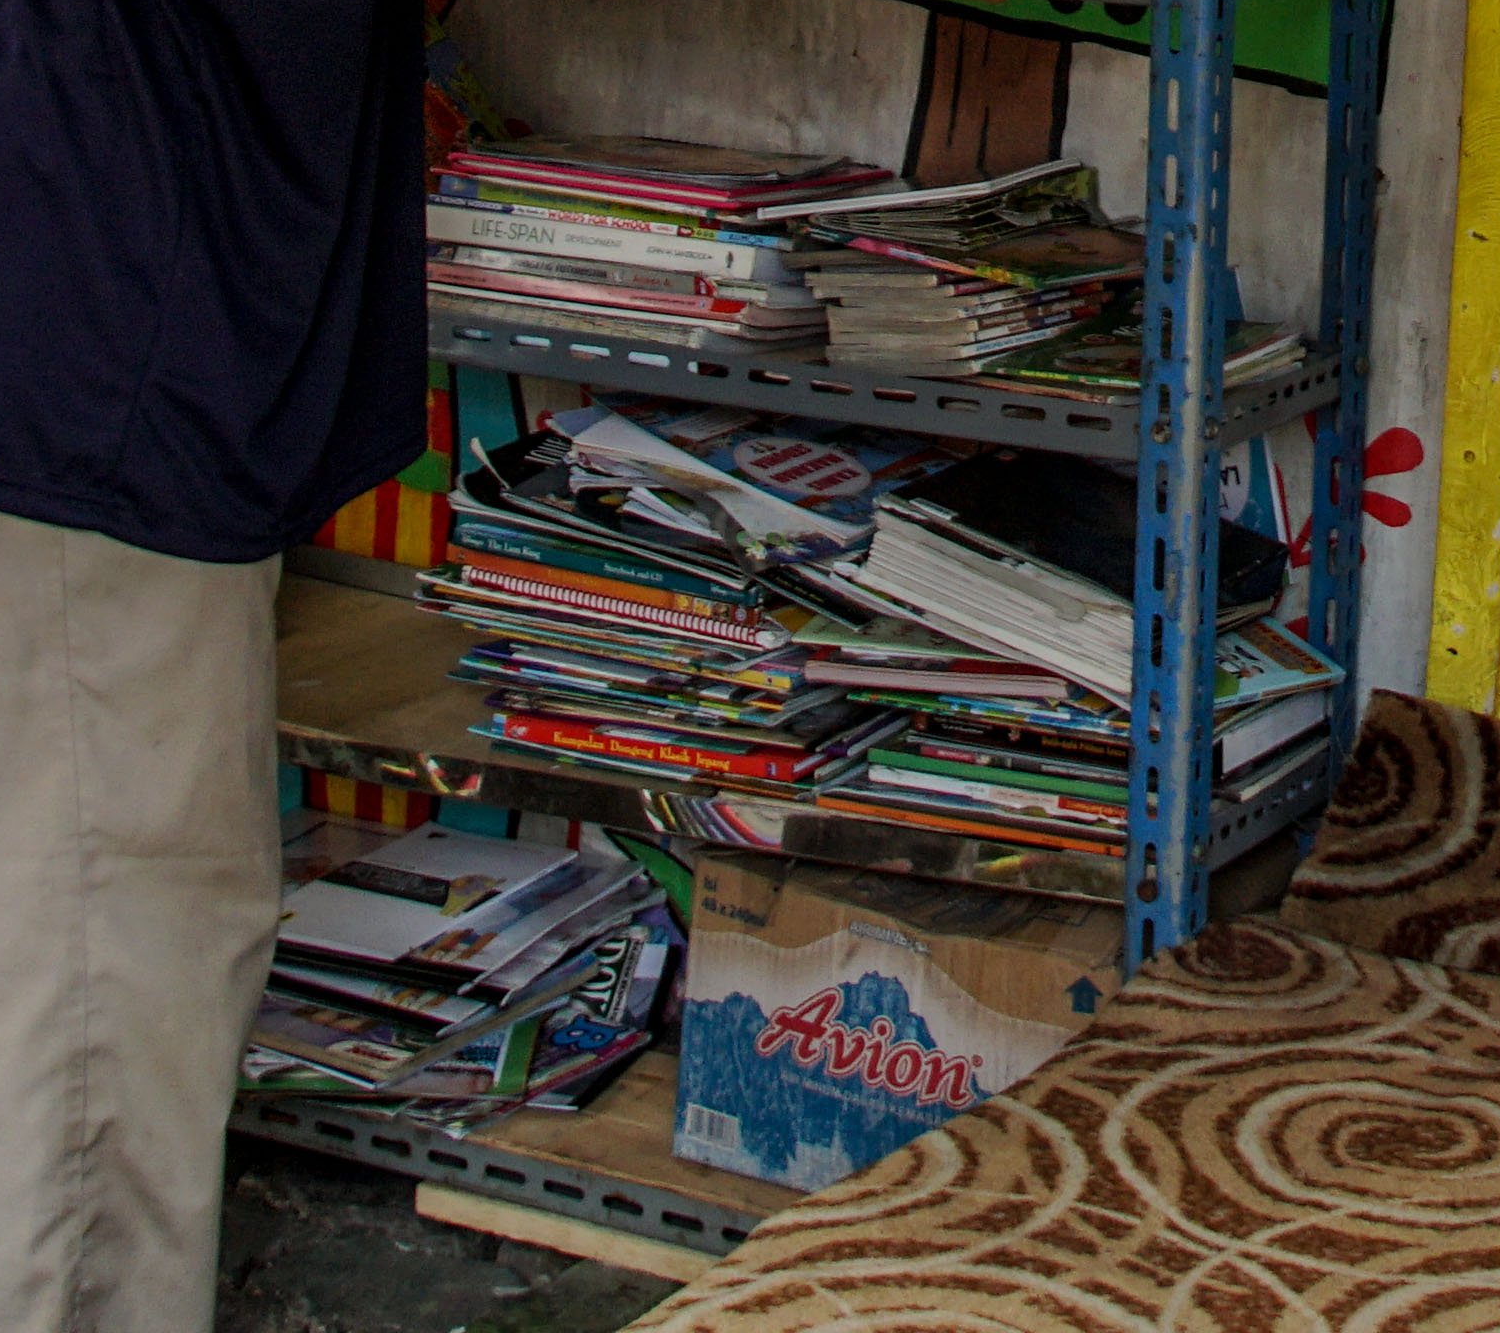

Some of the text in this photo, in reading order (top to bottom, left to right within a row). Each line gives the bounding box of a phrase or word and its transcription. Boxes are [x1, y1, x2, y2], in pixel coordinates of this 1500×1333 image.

[471, 217, 556, 244] LIFE-SPAN
[564, 233, 623, 248] DEVELOPMENT
[547, 210, 583, 223] WORDS
[587, 213, 608, 226] FOR
[610, 216, 657, 231] SCHOOL
[502, 541, 520, 555] Lion
[521, 545, 541, 561] King
[553, 732, 732, 772] Kumpulan Dongeng Klasik Jepang
[755, 985, 976, 1109] Avion
